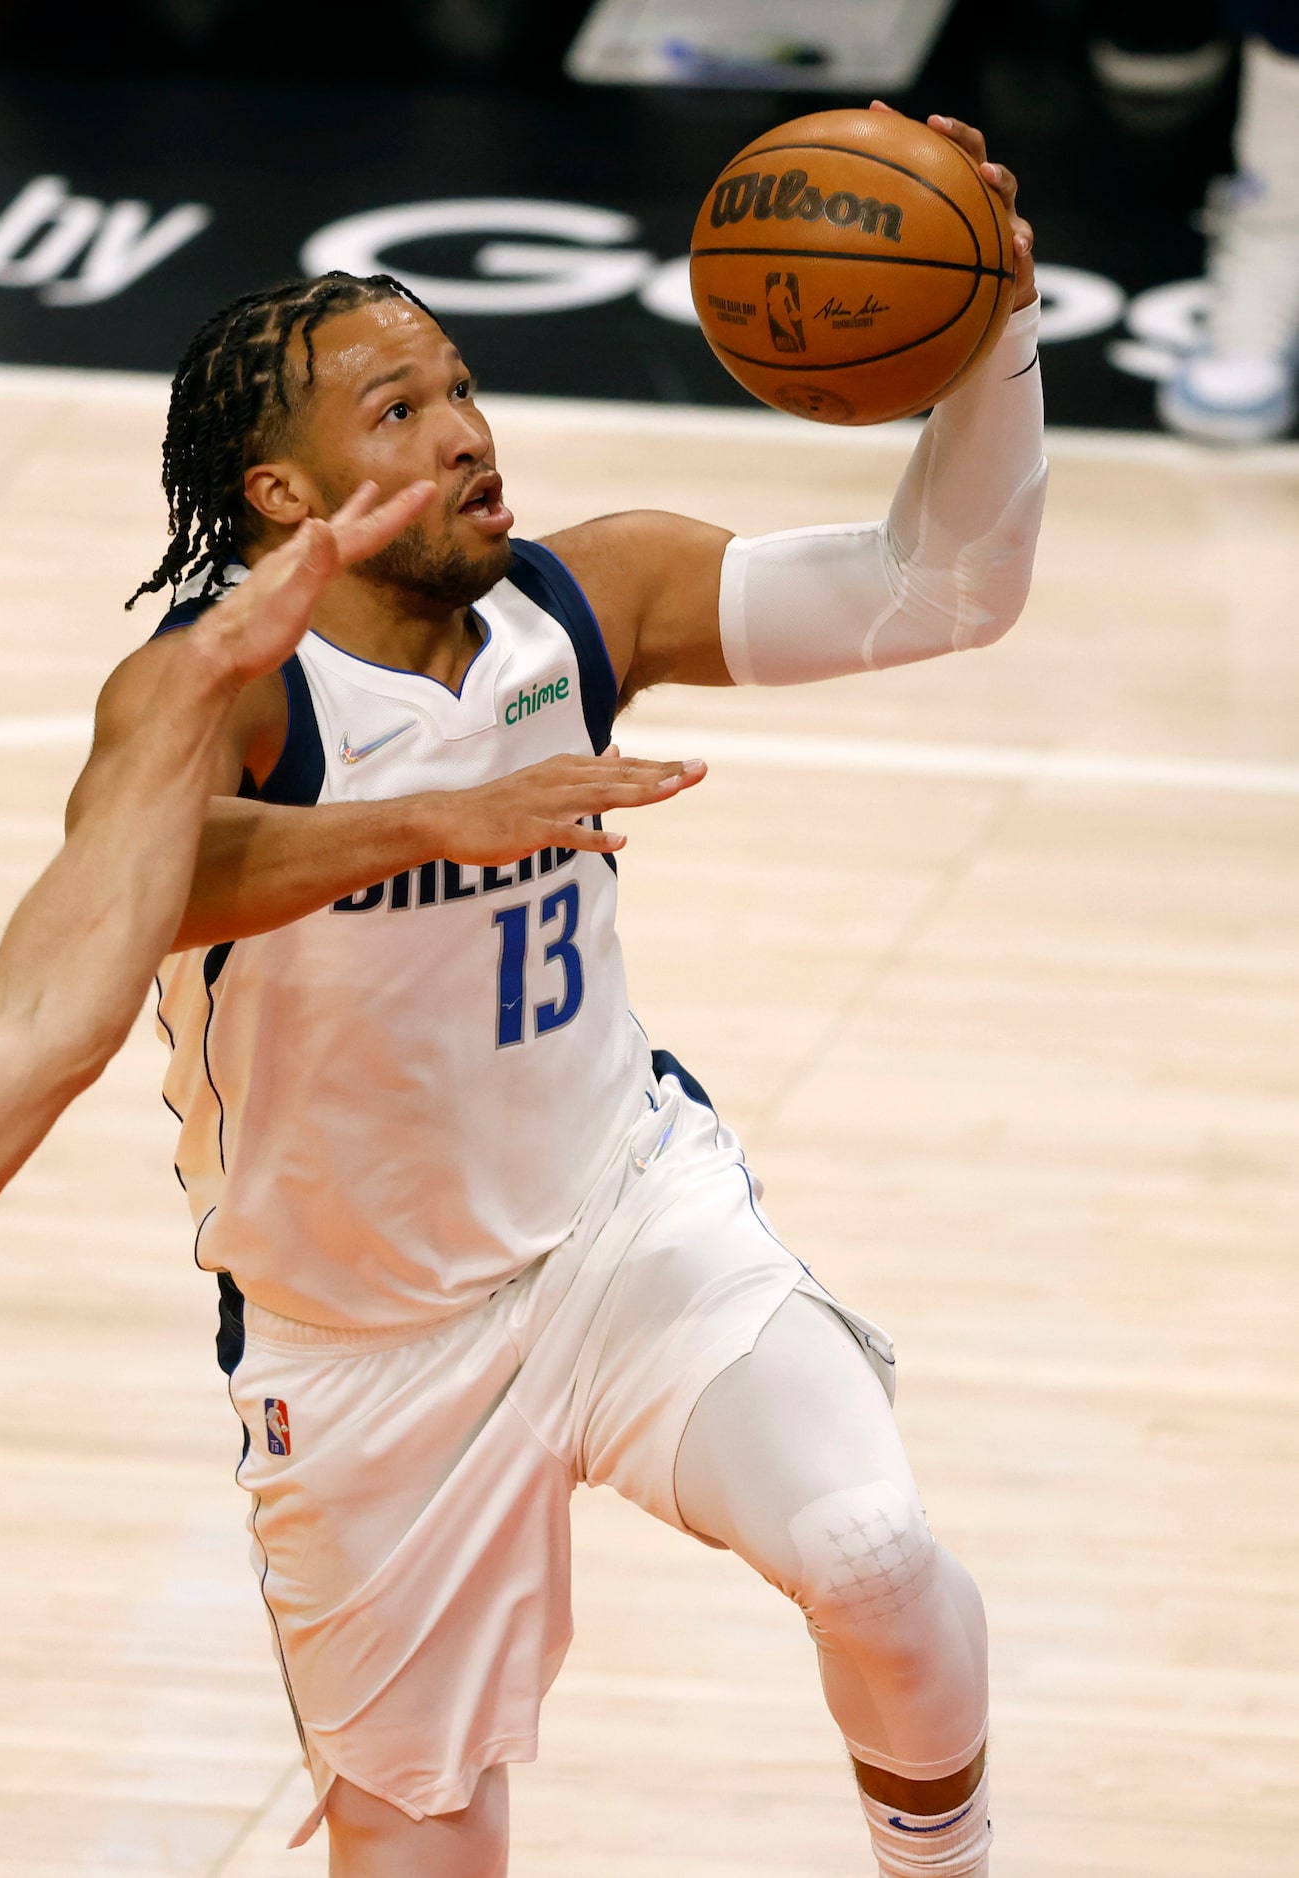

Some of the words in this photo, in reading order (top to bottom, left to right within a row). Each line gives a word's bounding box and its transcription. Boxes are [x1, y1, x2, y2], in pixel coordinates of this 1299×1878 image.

[710, 168, 904, 243] Wilson
[504, 675, 570, 726] chime
[491, 879, 584, 1050] 13
